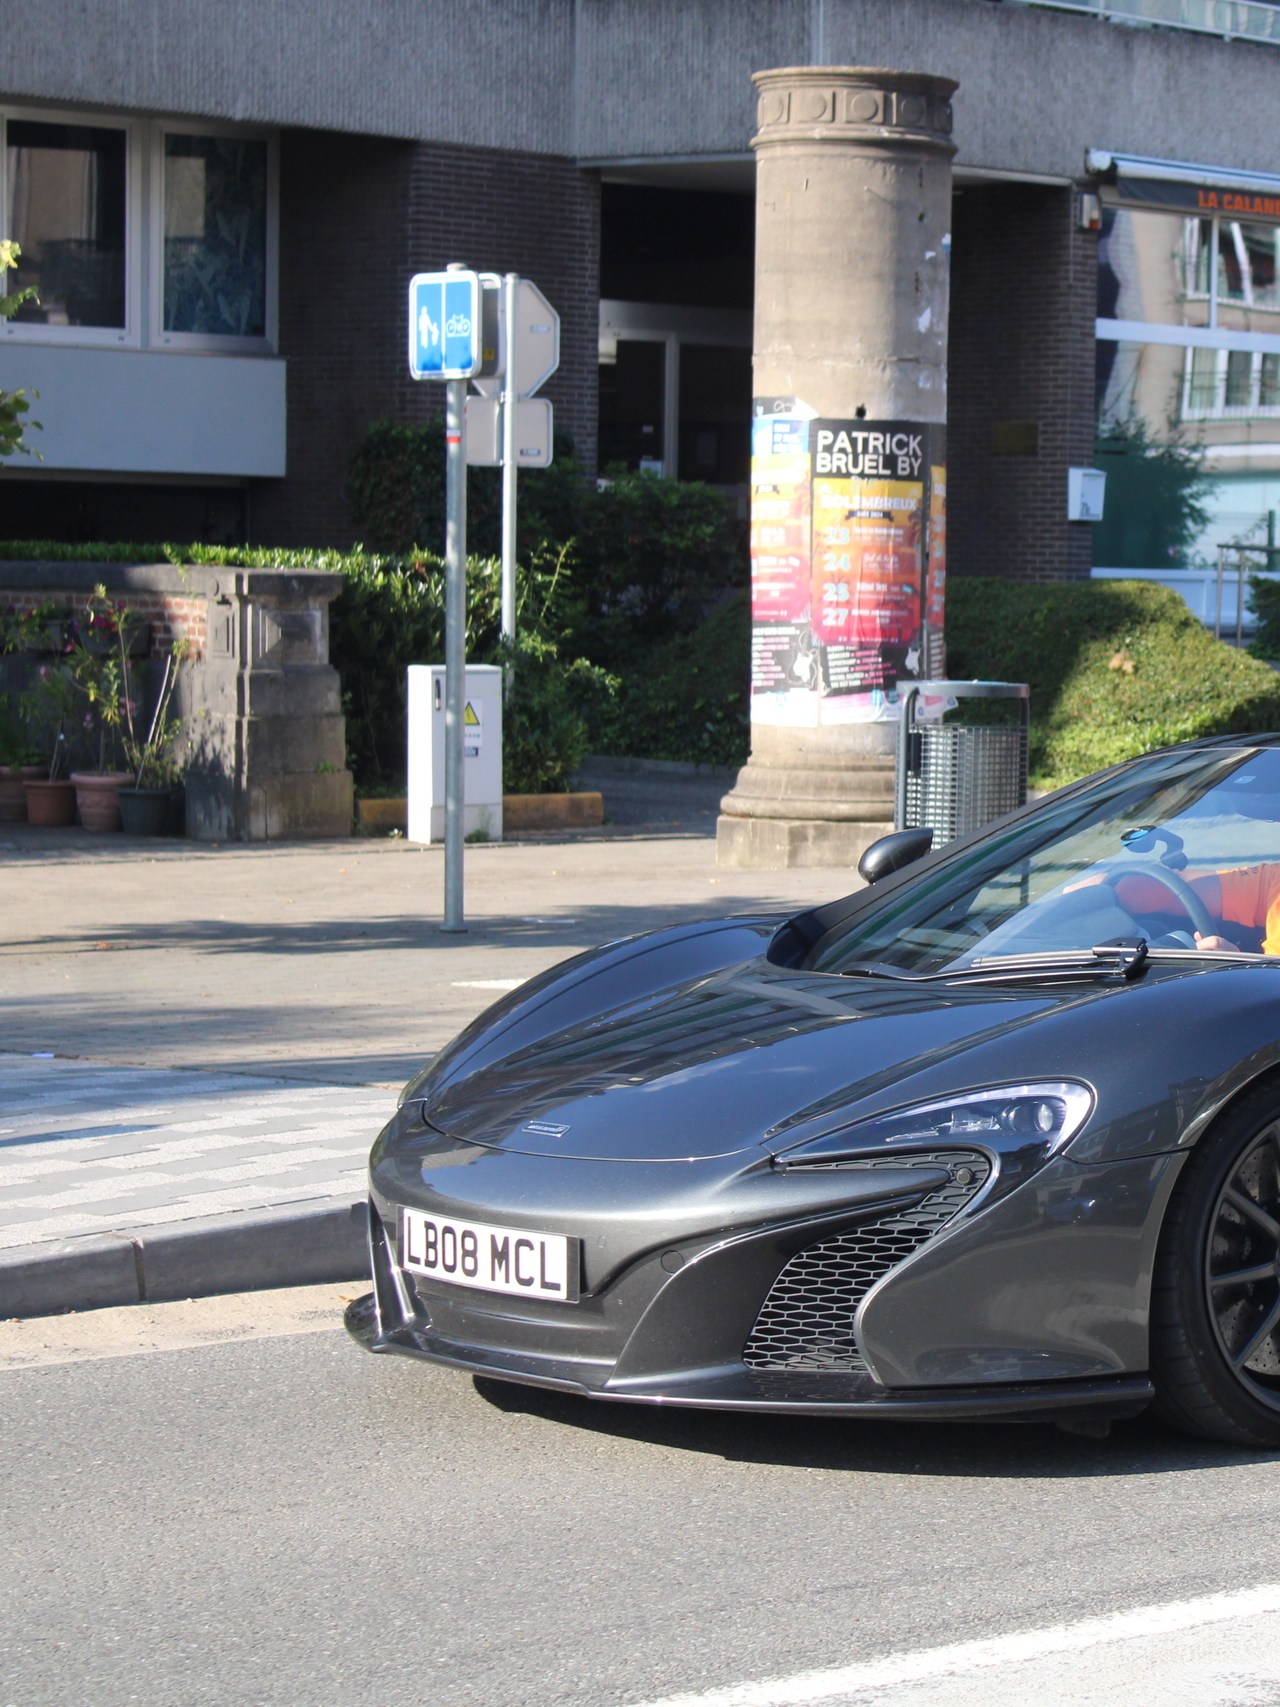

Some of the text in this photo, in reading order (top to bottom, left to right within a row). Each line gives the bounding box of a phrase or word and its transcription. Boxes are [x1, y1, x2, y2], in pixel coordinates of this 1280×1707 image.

[1198, 190, 1218, 208] LA
[817, 430, 922, 457] PATRICK
[816, 452, 922, 477] BRUEL BY
[821, 494, 916, 511] DOLEMBREUX
[823, 526, 850, 545] 23
[822, 553, 851, 571] 24
[822, 582, 850, 601] 25
[822, 608, 849, 626] 27
[408, 1216, 561, 1291] LB08 MCL
